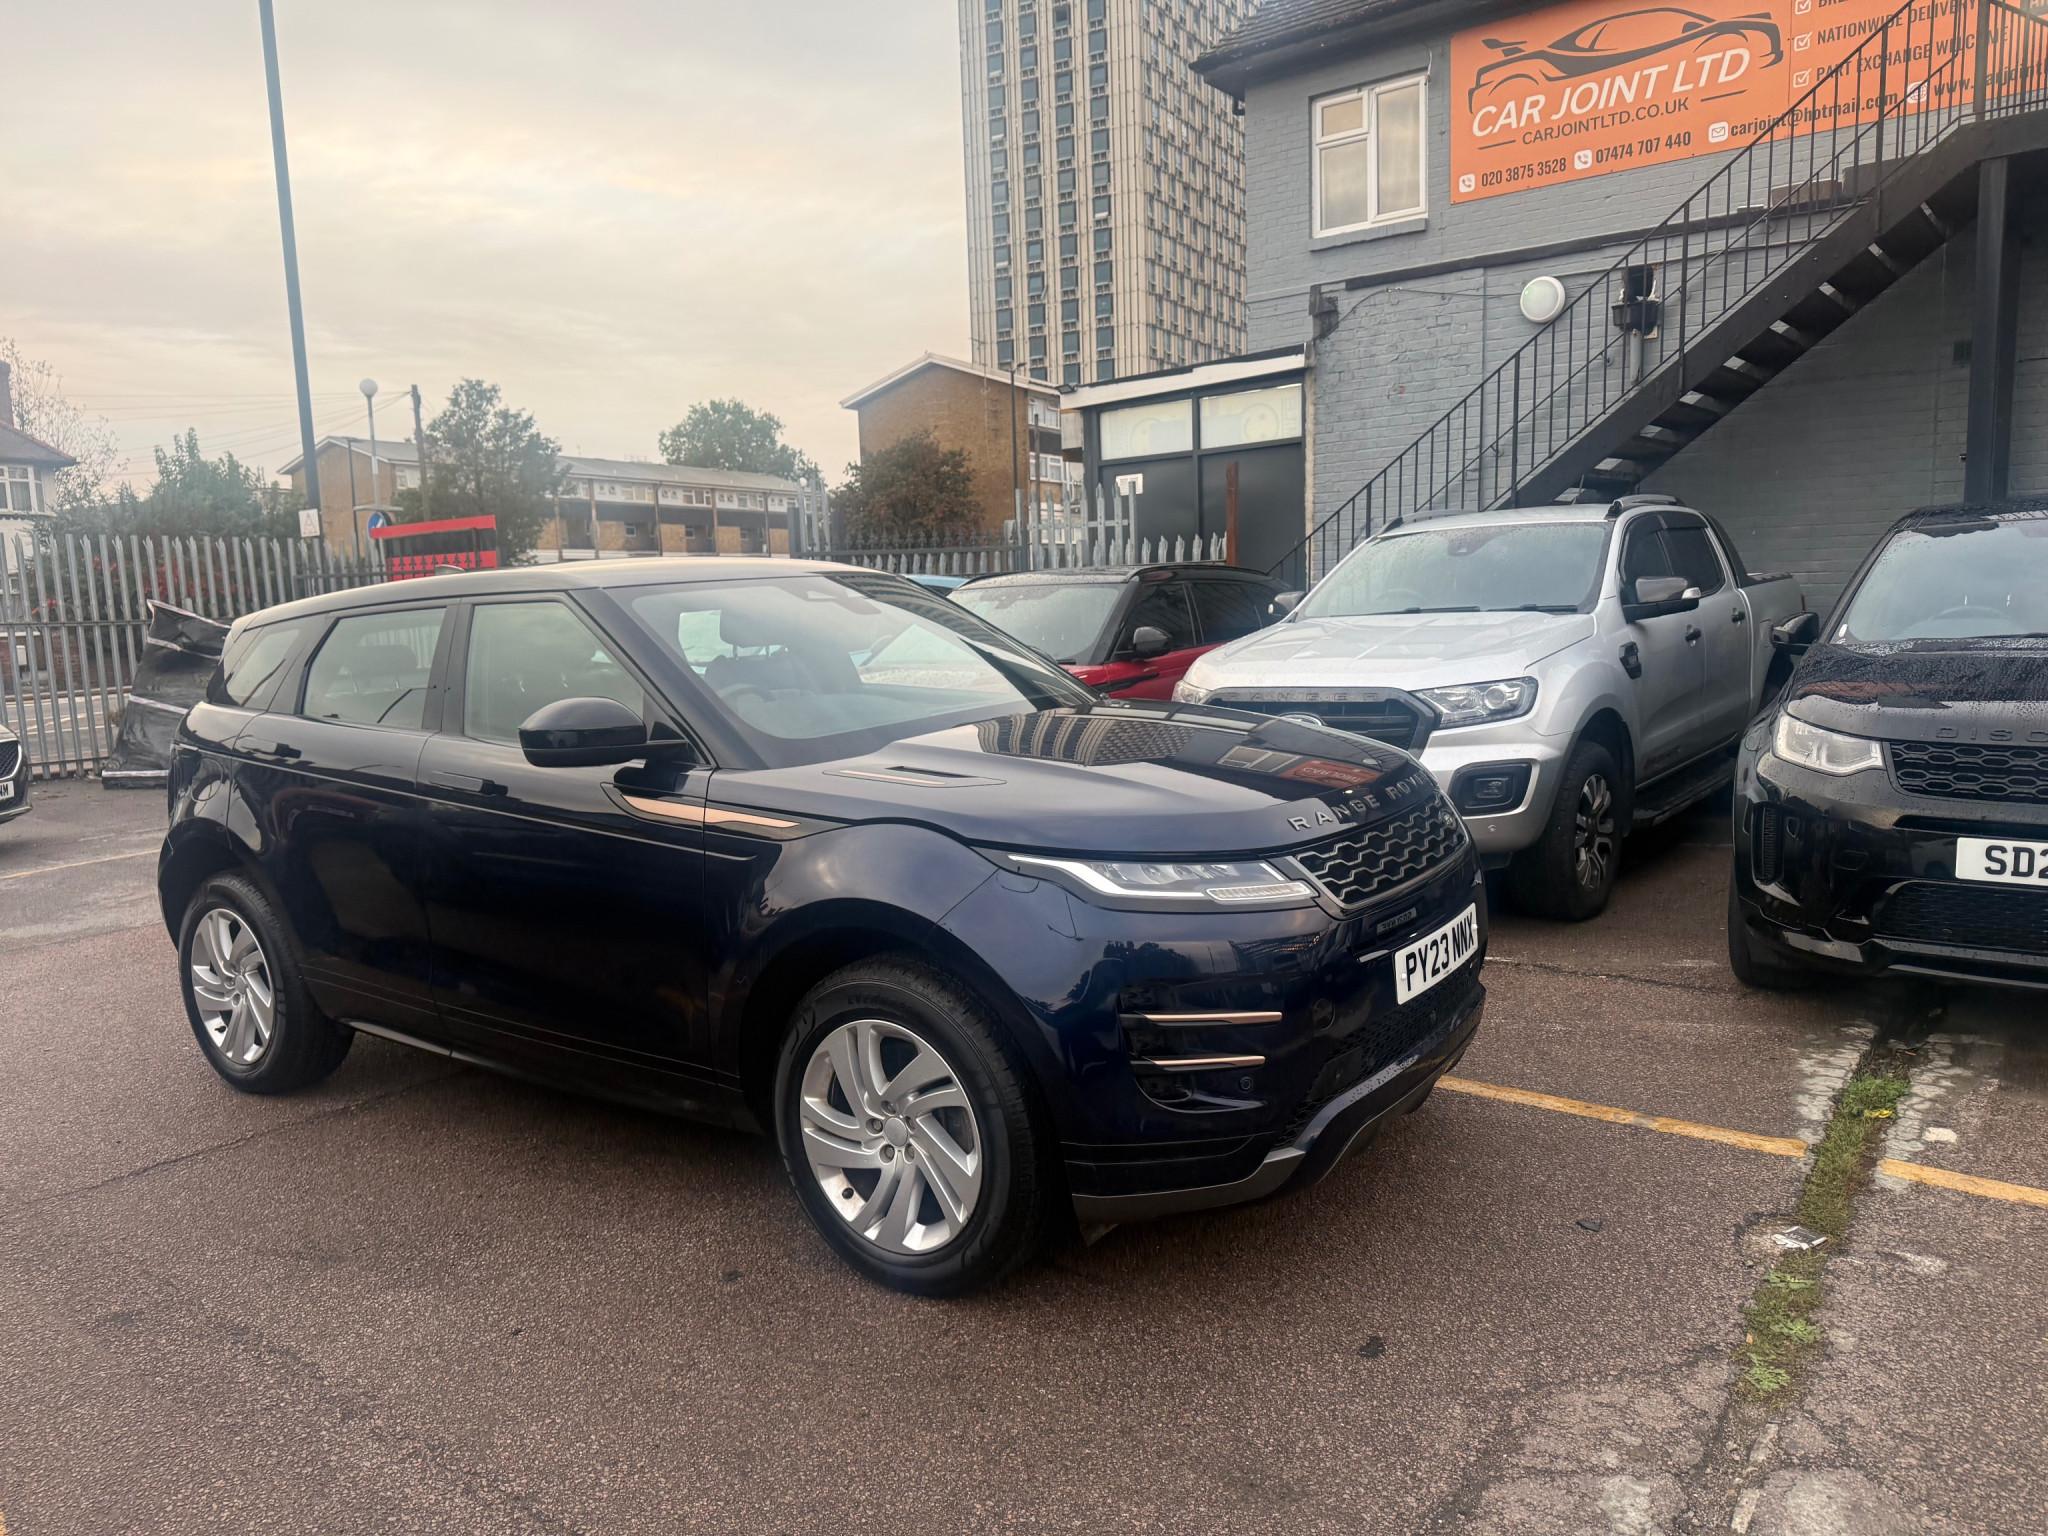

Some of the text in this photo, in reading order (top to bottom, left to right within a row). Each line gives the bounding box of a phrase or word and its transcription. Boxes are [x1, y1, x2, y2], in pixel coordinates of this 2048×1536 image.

[1472, 47, 1750, 137] CAR JOINT LTD
[1522, 96, 1689, 146] CARJOINTLTD.CO.UK
[1595, 131, 1692, 164] 07474 707 440
[1480, 157, 1567, 187] 020 3875 3528
[1287, 794, 1380, 832] RANGE
[1405, 932, 1450, 992] PY23
[1452, 913, 1475, 962] NNX
